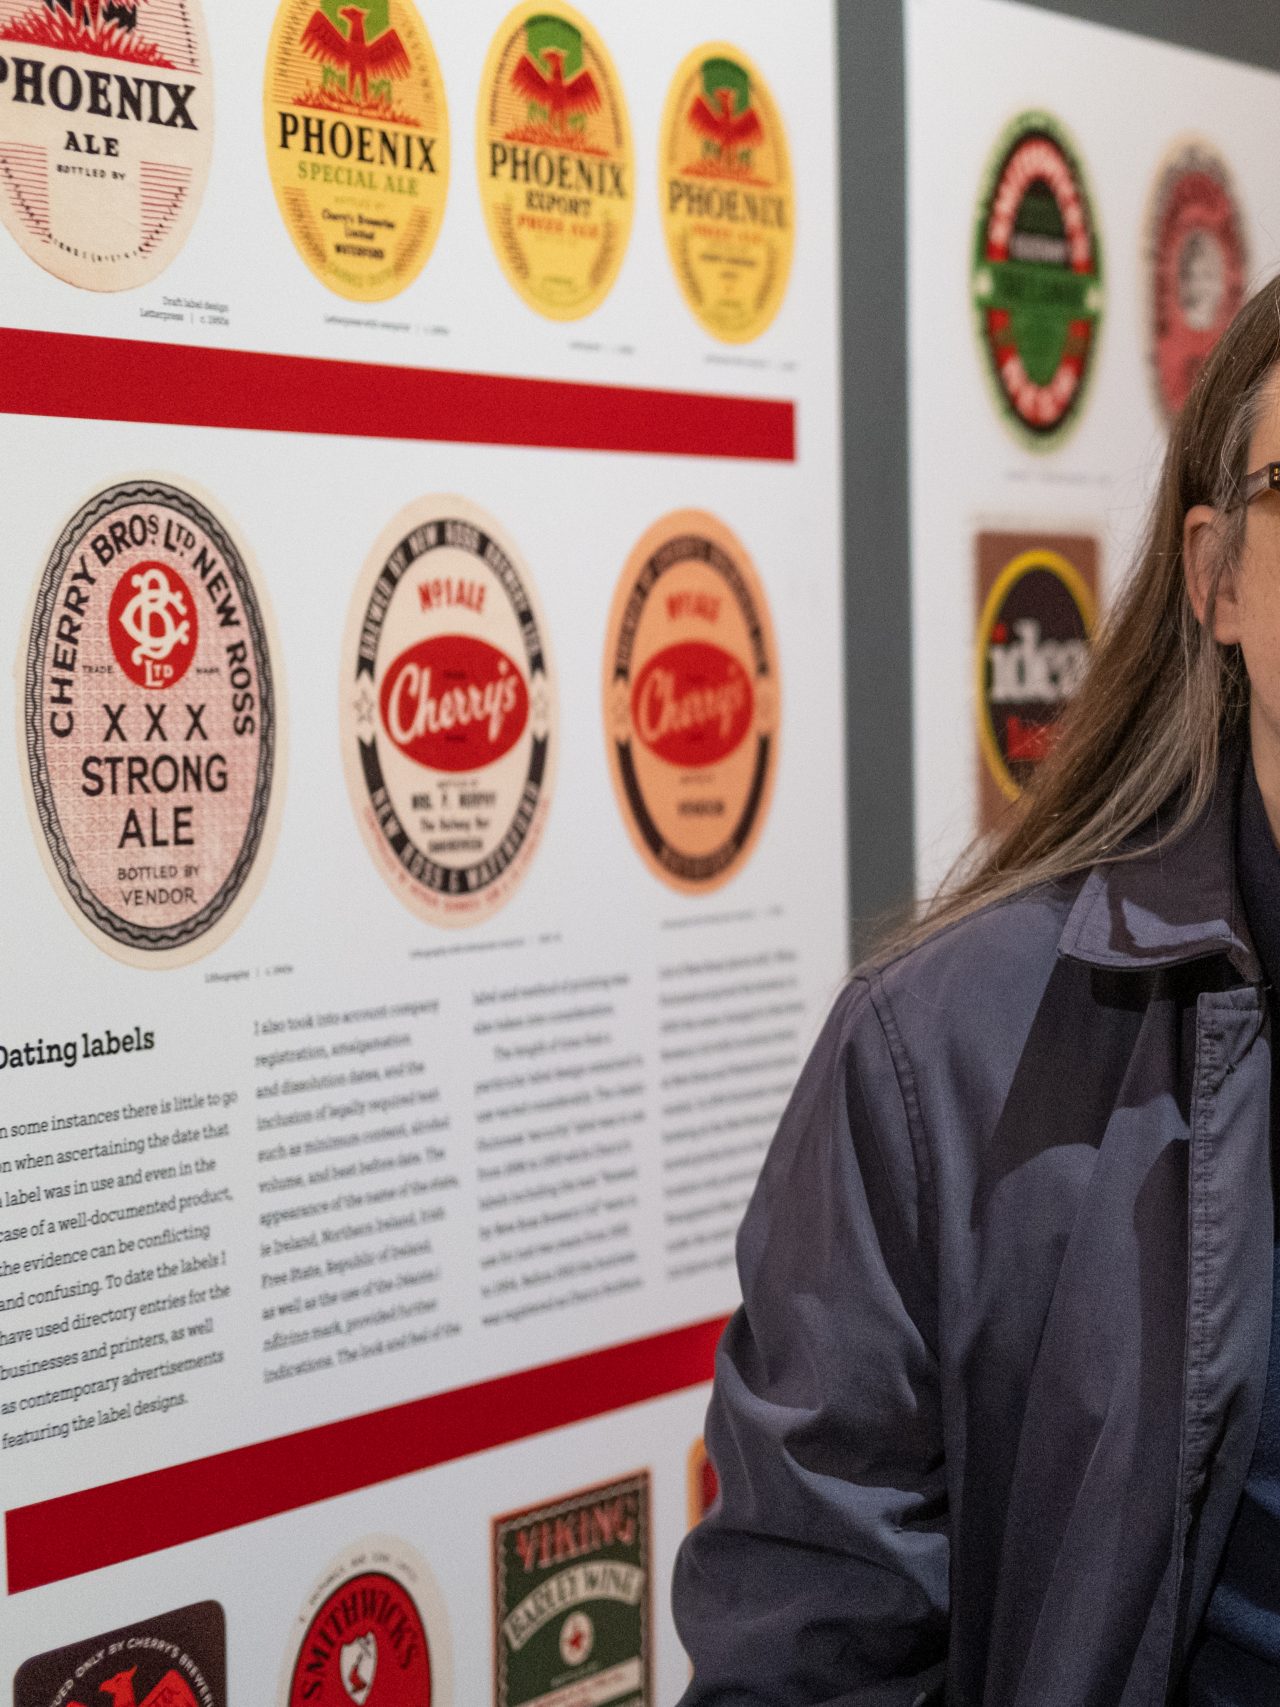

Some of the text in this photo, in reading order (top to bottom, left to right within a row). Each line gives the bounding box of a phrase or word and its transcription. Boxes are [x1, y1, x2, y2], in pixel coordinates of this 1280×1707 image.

[65, 131, 120, 157] ALE
[278, 111, 437, 175] PHOENIX
[56, 164, 126, 181] BOTTLED BY
[298, 160, 418, 197] SPECIAL ALE
[489, 142, 626, 199] PHOENIX
[525, 191, 591, 217] EXPORT
[669, 179, 786, 229] PHOENIX
[50, 555, 96, 738] CHERRY
[192, 546, 242, 629] NEW
[226, 640, 255, 736] ROSS
[388, 660, 518, 746] Cherry's
[81, 753, 229, 797] STRONG
[117, 806, 195, 849] ALE
[371, 786, 401, 840] NEW
[403, 843, 442, 892] ROSS
[117, 865, 200, 881] BOTTLED BY
[121, 887, 198, 905] VENDOR
[82, 1027, 155, 1059] labels
[261, 1018, 285, 1035] also
[11, 1091, 238, 1138] some instances there is little to go
[256, 1081, 279, 1099] and
[15, 1123, 229, 1170] when ascertaining the date that
[5, 1157, 216, 1208] label was in use and even in the
[30, 1187, 234, 1236] of a well-documented product,
[0, 1224, 210, 1277] the evidence can be conflicting
[0, 1291, 24, 1312] and
[27, 1279, 103, 1306] confusing.
[105, 1274, 122, 1289] To
[124, 1267, 154, 1286] date
[156, 1262, 178, 1279] the
[180, 1252, 218, 1274] labels
[261, 1273, 288, 1289] Free
[0, 1283, 231, 1347] have used directory entries for the
[0, 1318, 213, 1381] businesses and printers, as well
[1, 1350, 224, 1415] as contemporary advertisements
[2, 1393, 188, 1450] featuring the label designs.
[516, 1494, 638, 1574] VIKING
[508, 1564, 642, 1644] BARLEY WINE
[50, 1637, 181, 1707] UED ONLY BY CHERRY'S
